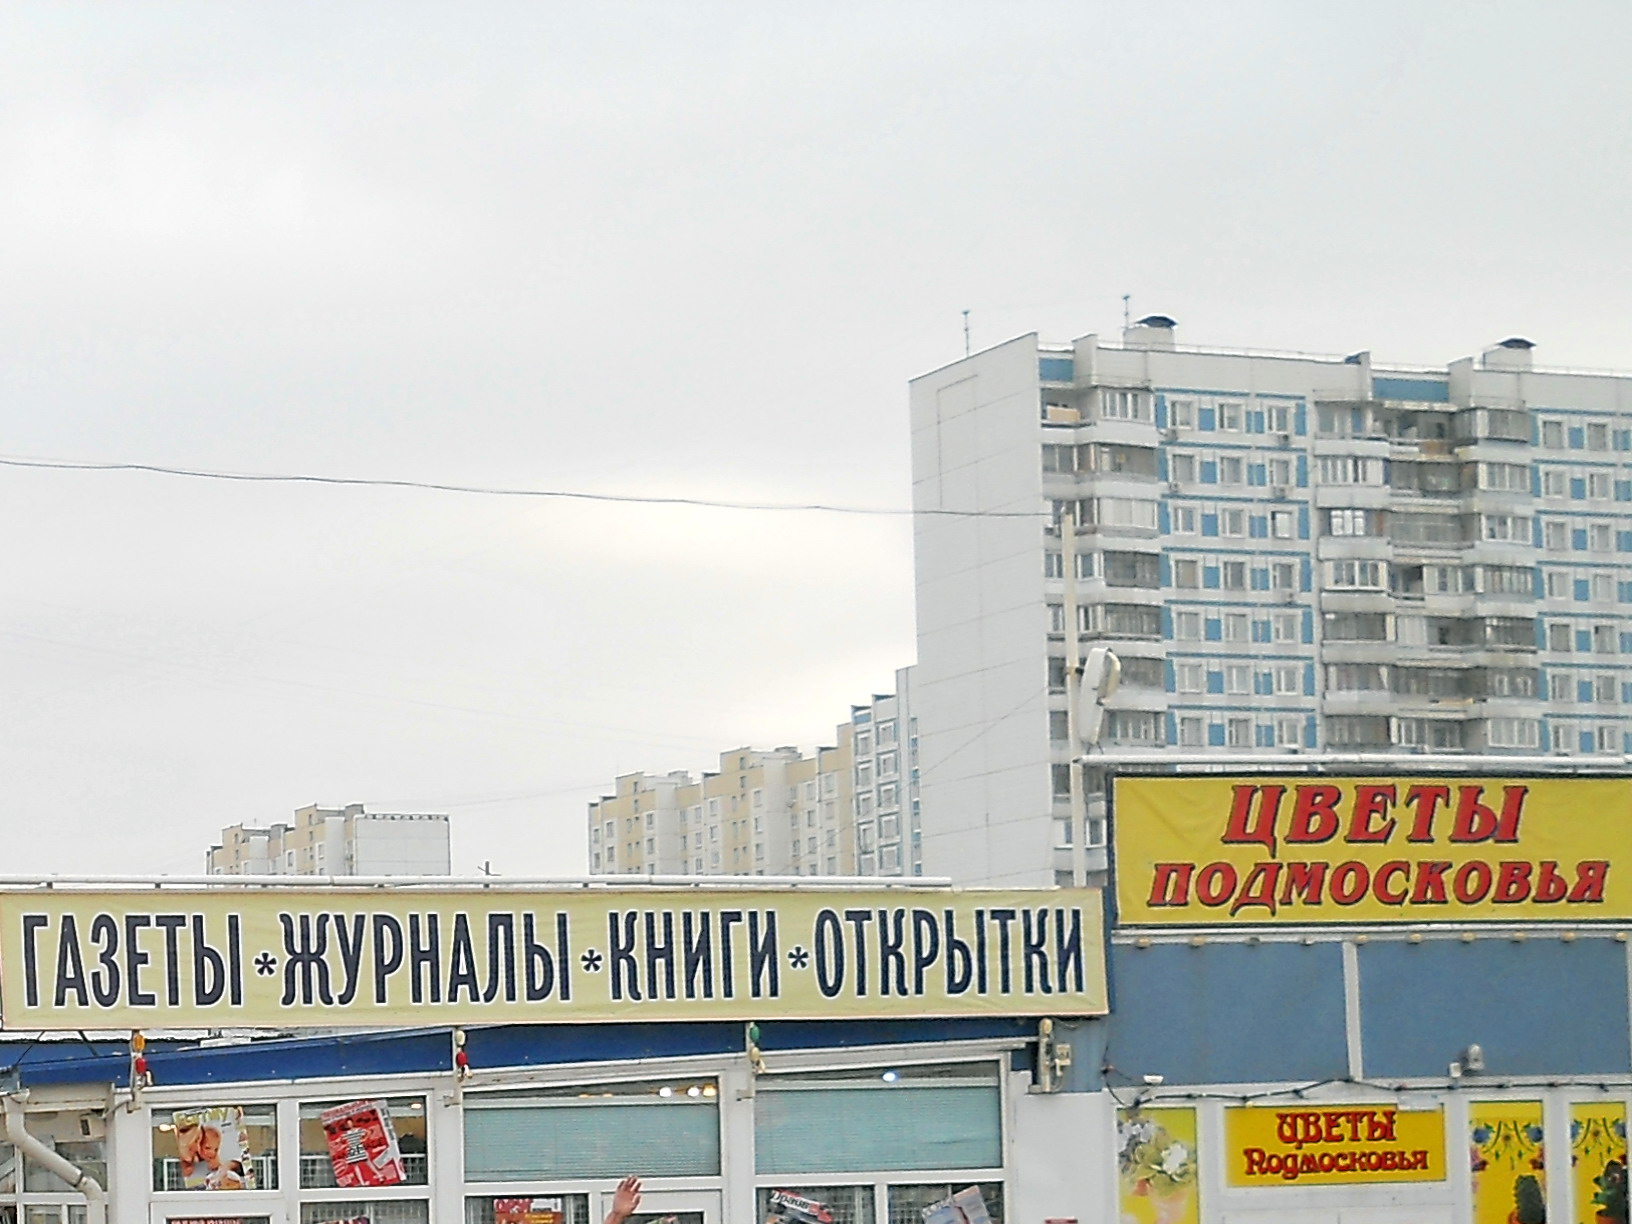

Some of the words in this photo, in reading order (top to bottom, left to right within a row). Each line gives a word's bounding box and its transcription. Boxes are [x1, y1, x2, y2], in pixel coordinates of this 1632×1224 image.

[1221, 784, 1528, 859] ЦВЕТЫ
[1147, 860, 1609, 917] ПОДМОСКОВЬЯ
[22, 914, 242, 1007] ГАЗЕТЫ
[280, 912, 568, 1006] ЖУРНАЛЫ
[609, 909, 779, 1001] КНИГИ
[814, 908, 1084, 998] ОТКРЫТКИ
[1276, 1111, 1396, 1149] ЦВЕТЫ
